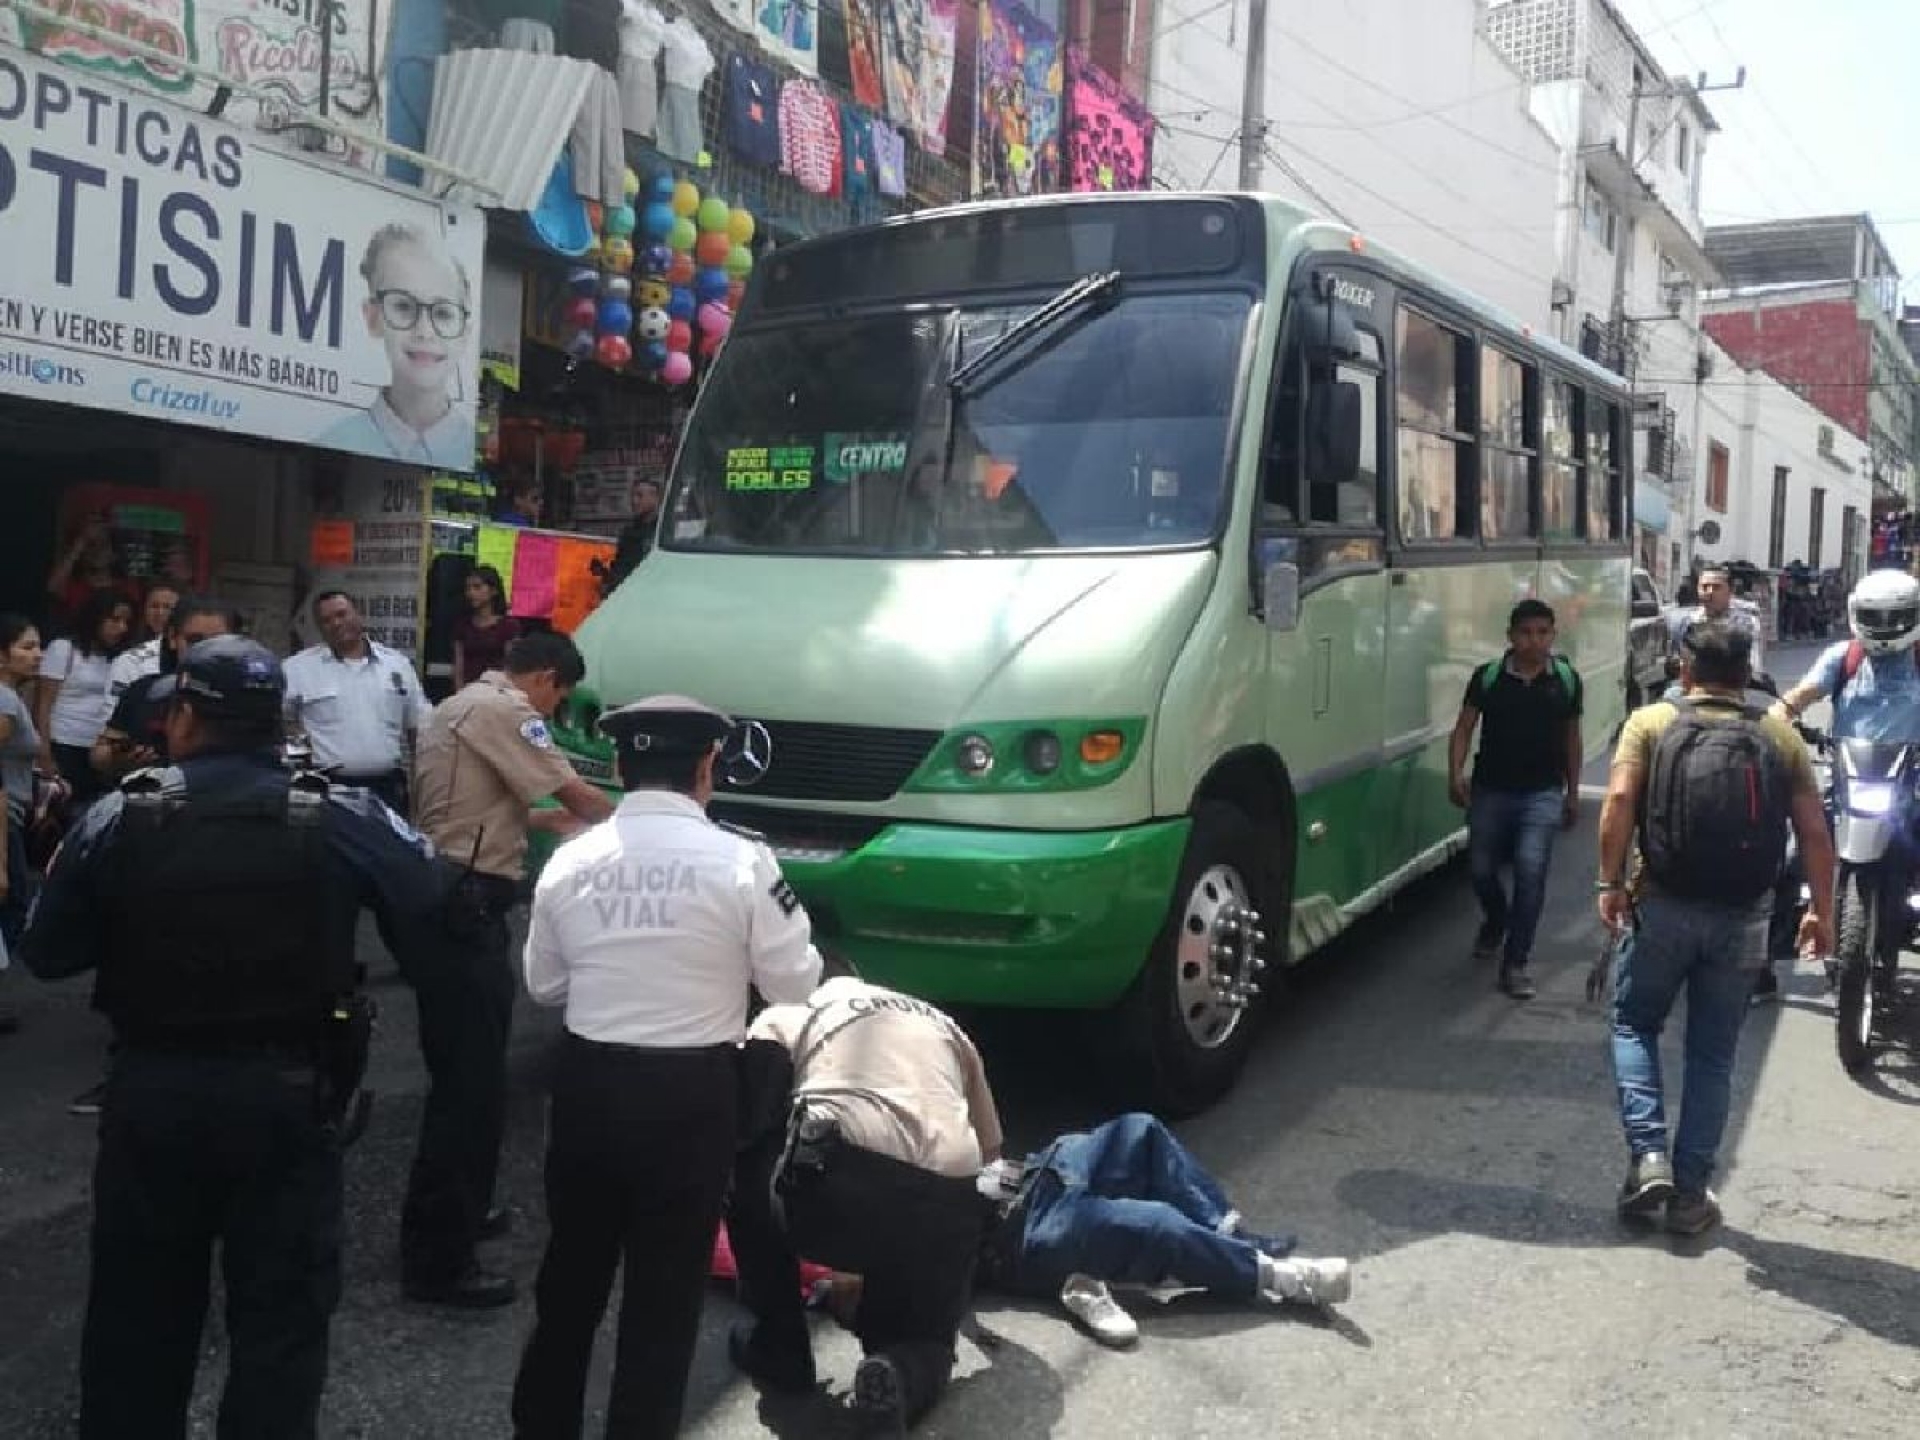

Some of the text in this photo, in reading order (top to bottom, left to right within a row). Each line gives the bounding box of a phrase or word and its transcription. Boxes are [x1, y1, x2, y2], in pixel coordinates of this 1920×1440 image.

[0, 143, 346, 349] TISIM
[31, 304, 46, 334] Y
[55, 309, 127, 351] VERSE
[133, 328, 183, 362] BIEN
[190, 339, 212, 368] ES
[219, 346, 263, 379] MÁS
[130, 377, 208, 412] Crizal
[839, 442, 907, 472] CENTRO
[574, 858, 697, 894] POLICÍA
[591, 896, 678, 929] VIAL
